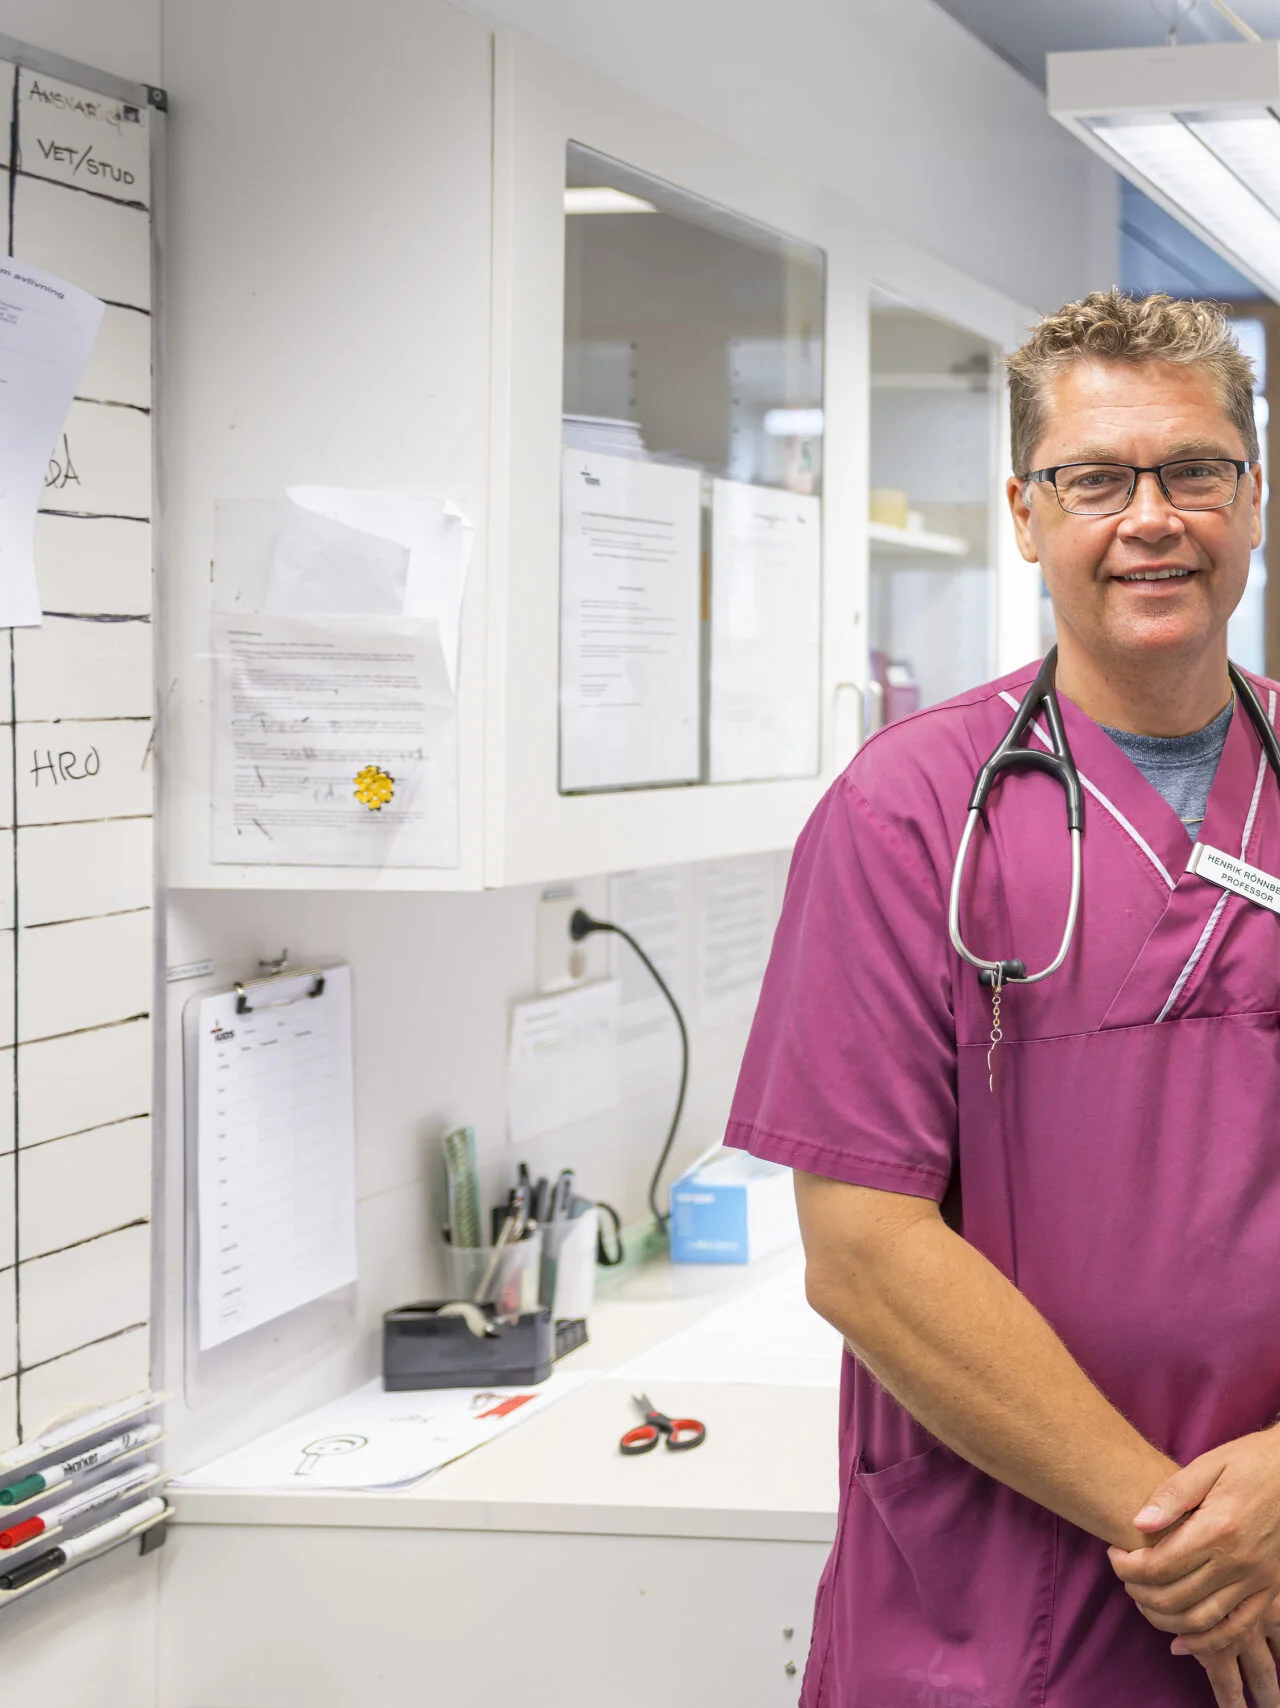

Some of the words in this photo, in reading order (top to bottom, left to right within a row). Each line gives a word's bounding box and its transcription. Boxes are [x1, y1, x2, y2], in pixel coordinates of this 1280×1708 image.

[37, 138, 135, 185] VET/STUD
[14, 274, 65, 300] avlivning
[1207, 854, 1242, 875] HENRIK
[1221, 873, 1274, 903] PROFESSOR
